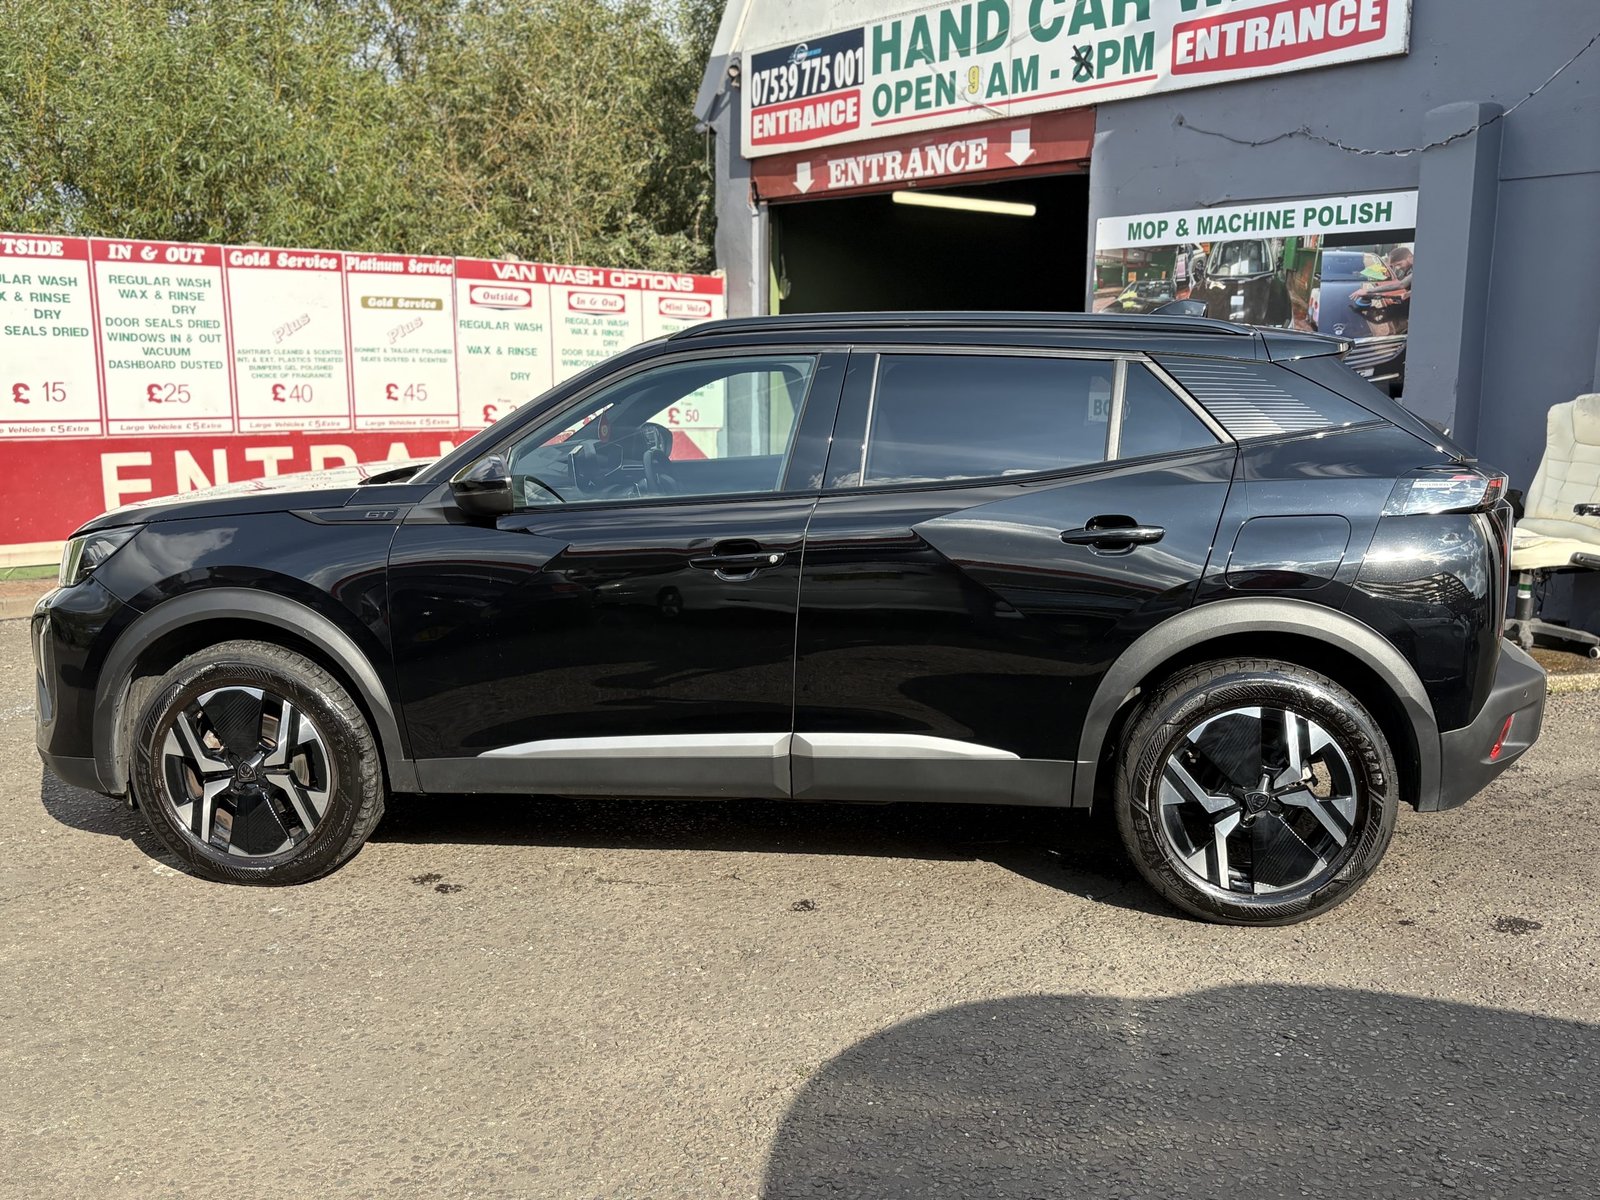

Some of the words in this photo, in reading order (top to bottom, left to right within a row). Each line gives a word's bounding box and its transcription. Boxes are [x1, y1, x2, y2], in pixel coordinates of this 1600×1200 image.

[872, 0, 1010, 75] HAND
[1176, 0, 1382, 65] ENTRANCE
[752, 63, 798, 107] 07539
[801, 55, 831, 96] 775
[834, 46, 864, 88] 001
[872, 70, 957, 118] OPEN
[985, 54, 1039, 99] AM
[753, 96, 858, 139] ENTRANCE
[827, 137, 988, 189] ENTRANCE
[1128, 220, 1169, 241] MOP
[1175, 218, 1190, 237] &
[1197, 209, 1296, 235] MACHINE
[1303, 201, 1393, 227] POLISH
[0, 239, 64, 257] TSIDE
[108, 244, 133, 260] IN
[140, 246, 158, 261] &
[165, 247, 205, 263] OUT
[229, 250, 271, 268] Gold
[276, 252, 338, 270] Service
[346, 256, 404, 273] Platinum
[407, 259, 454, 275] Service
[38, 275, 78, 287] WASH
[108, 274, 171, 287] REGULAR
[176, 277, 212, 289] WASH
[492, 263, 538, 282] VAN
[542, 267, 604, 286] WASH
[609, 271, 695, 292] OPTIONS
[14, 291, 23, 302] &
[29, 292, 72, 304] RINSE
[118, 289, 149, 300] WAX
[154, 290, 163, 300] &
[168, 291, 206, 302] RINSE
[482, 291, 520, 302] Outside
[576, 297, 586, 305] In
[601, 298, 617, 307] Out
[171, 305, 197, 315] DRY
[367, 297, 393, 308] Gold
[396, 298, 437, 310] Service
[34, 308, 62, 320] DRY
[105, 317, 140, 328] DOOR
[145, 318, 184, 329] SEALS
[187, 319, 221, 330] DRIED
[272, 313, 311, 344] Plus
[459, 320, 510, 331] REGULAR
[514, 322, 543, 332] WASH
[564, 317, 604, 326] REGULAR
[607, 319, 629, 327] WASH
[4, 325, 48, 337] SEALS
[52, 326, 90, 338] DRIED
[387, 316, 424, 345] Plus
[570, 328, 589, 336] WAX
[601, 329, 625, 338] RINSE
[106, 332, 166, 344] WINDOWS
[170, 333, 182, 343] IN
[198, 334, 223, 343] OUT
[602, 339, 619, 348] DRY
[142, 346, 191, 356] VACUUM
[467, 345, 491, 355] WAX
[496, 346, 503, 355] &
[507, 346, 538, 357] RINSE
[108, 360, 176, 370] DASHBOARD
[180, 360, 224, 370] DUSTED
[510, 372, 531, 382] DRY
[42, 382, 67, 403] 15
[146, 382, 192, 404] £25
[364, 510, 395, 519] GT
